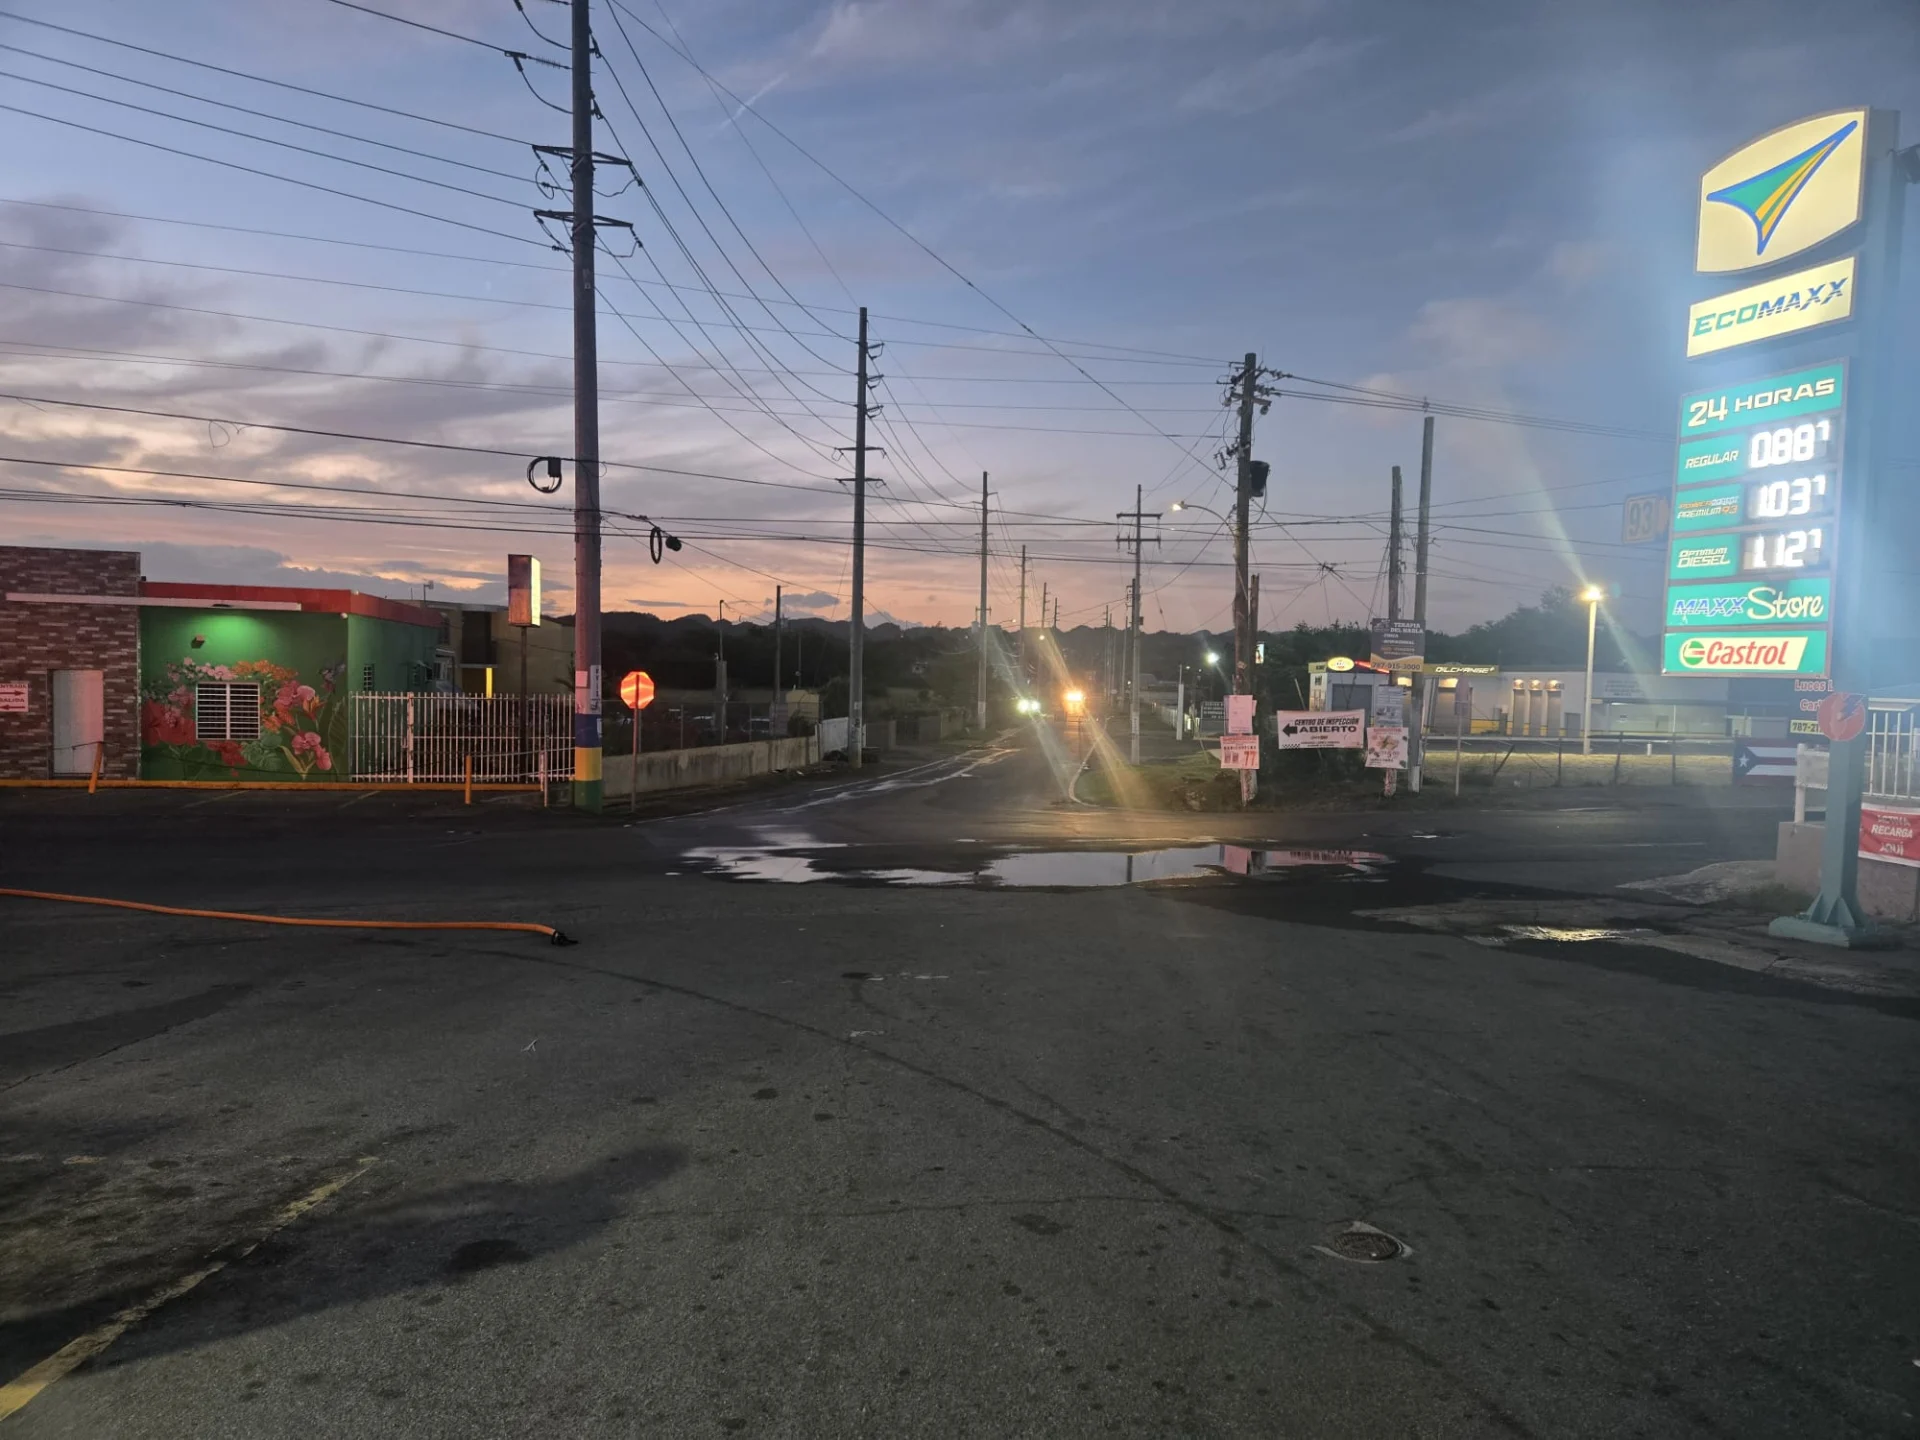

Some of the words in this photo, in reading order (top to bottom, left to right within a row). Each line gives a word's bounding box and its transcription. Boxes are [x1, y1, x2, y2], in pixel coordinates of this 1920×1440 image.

[1692, 276, 1848, 337] ECOMAXX
[1688, 395, 1728, 427] 24
[1734, 378, 1835, 412] HORAS
[1684, 450, 1739, 469] REGULAR
[1679, 547, 1728, 558] OPTIMUM
[1677, 555, 1730, 568] DIESEL
[1672, 597, 1748, 617] MAXX
[1746, 587, 1824, 620] Store
[1706, 641, 1789, 665] Castrol
[1795, 679, 1826, 692] Luces
[1299, 725, 1357, 733] ABIERTO
[1871, 824, 1913, 838] RECARGA
